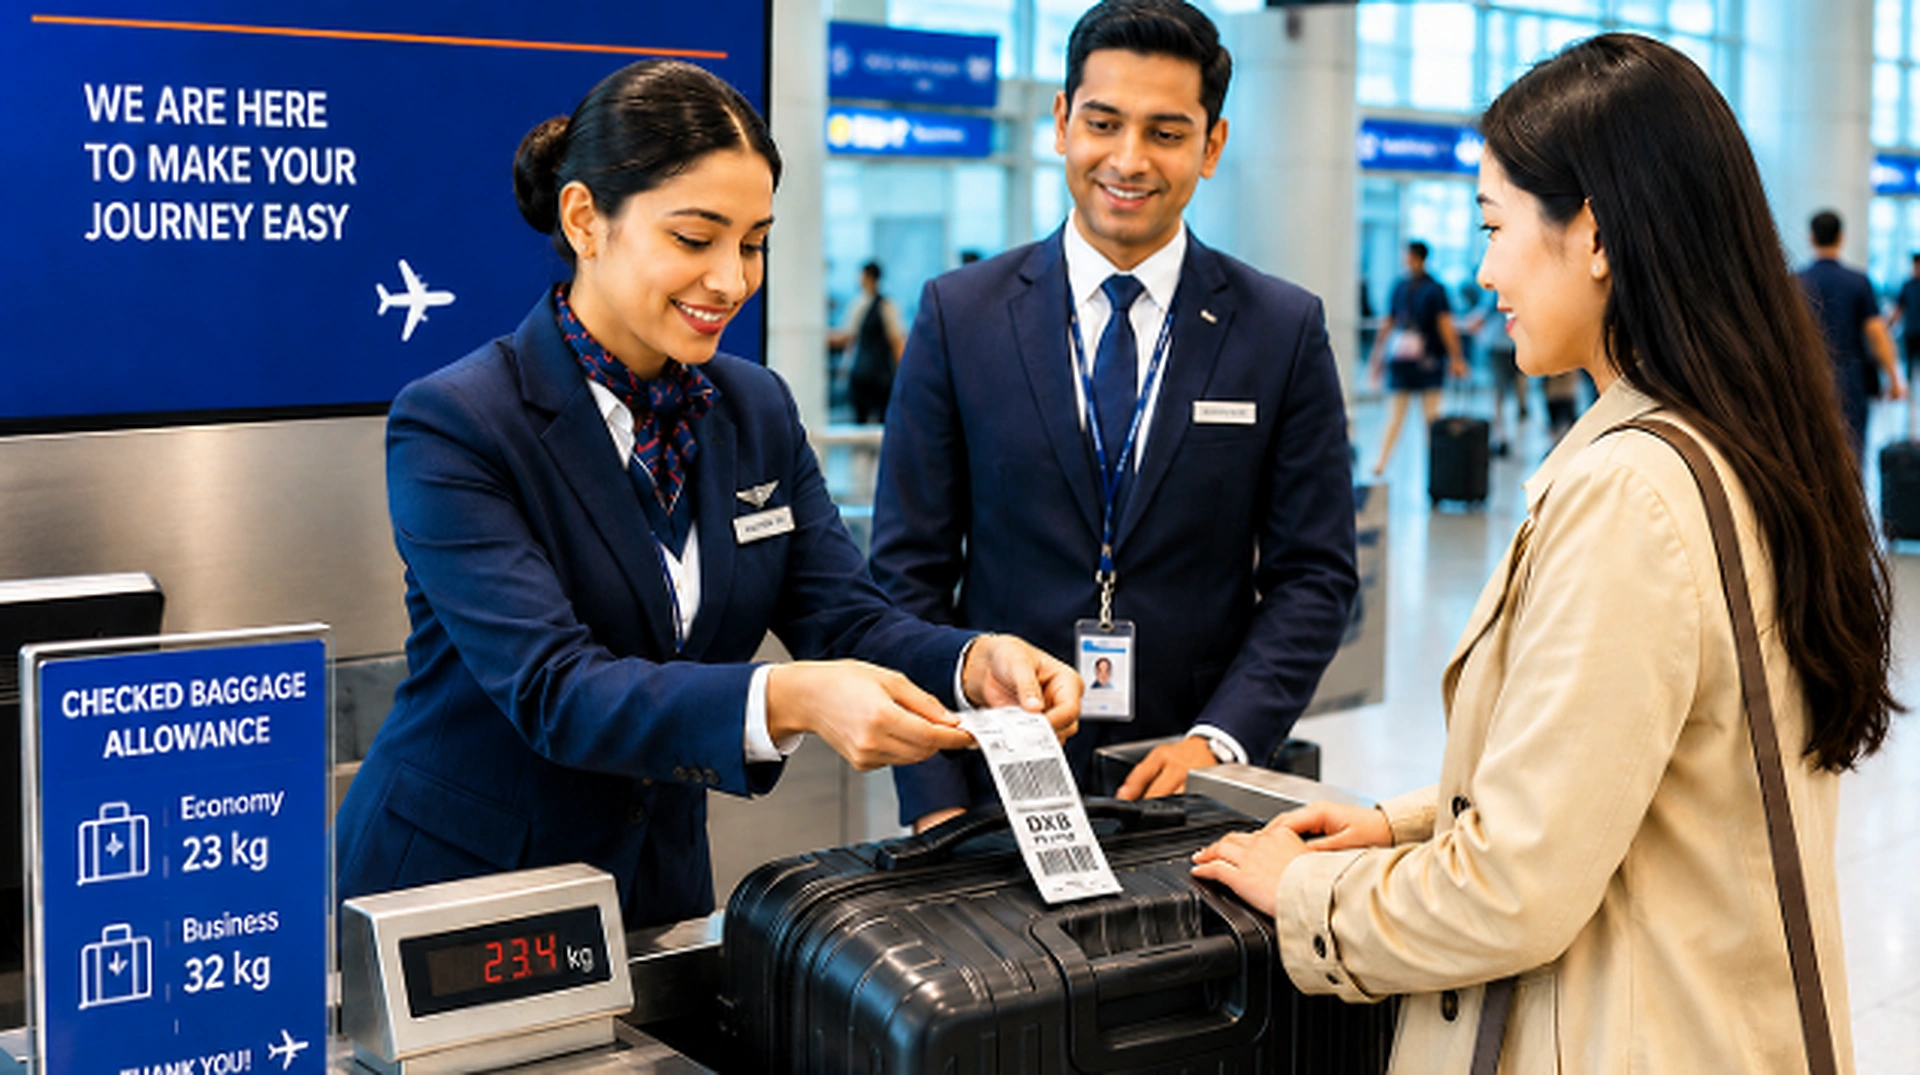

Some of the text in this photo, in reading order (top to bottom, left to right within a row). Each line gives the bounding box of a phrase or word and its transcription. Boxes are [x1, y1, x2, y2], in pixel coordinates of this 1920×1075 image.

[84, 83, 328, 128] WE ARE HERE
[84, 142, 357, 186] TO MAKE YOUR
[84, 201, 350, 241] JOURNEY EASY
[61, 671, 307, 719] CHECKED BAGGAGE
[103, 715, 271, 759] ALLOWANCE
[181, 790, 285, 821] Economy
[1026, 812, 1072, 833] DXB
[182, 830, 269, 872] 23 kg
[183, 910, 279, 943] Business
[183, 950, 270, 993] 32 kg
[566, 946, 594, 973] kg
[200, 1050, 252, 1075] YOU!
